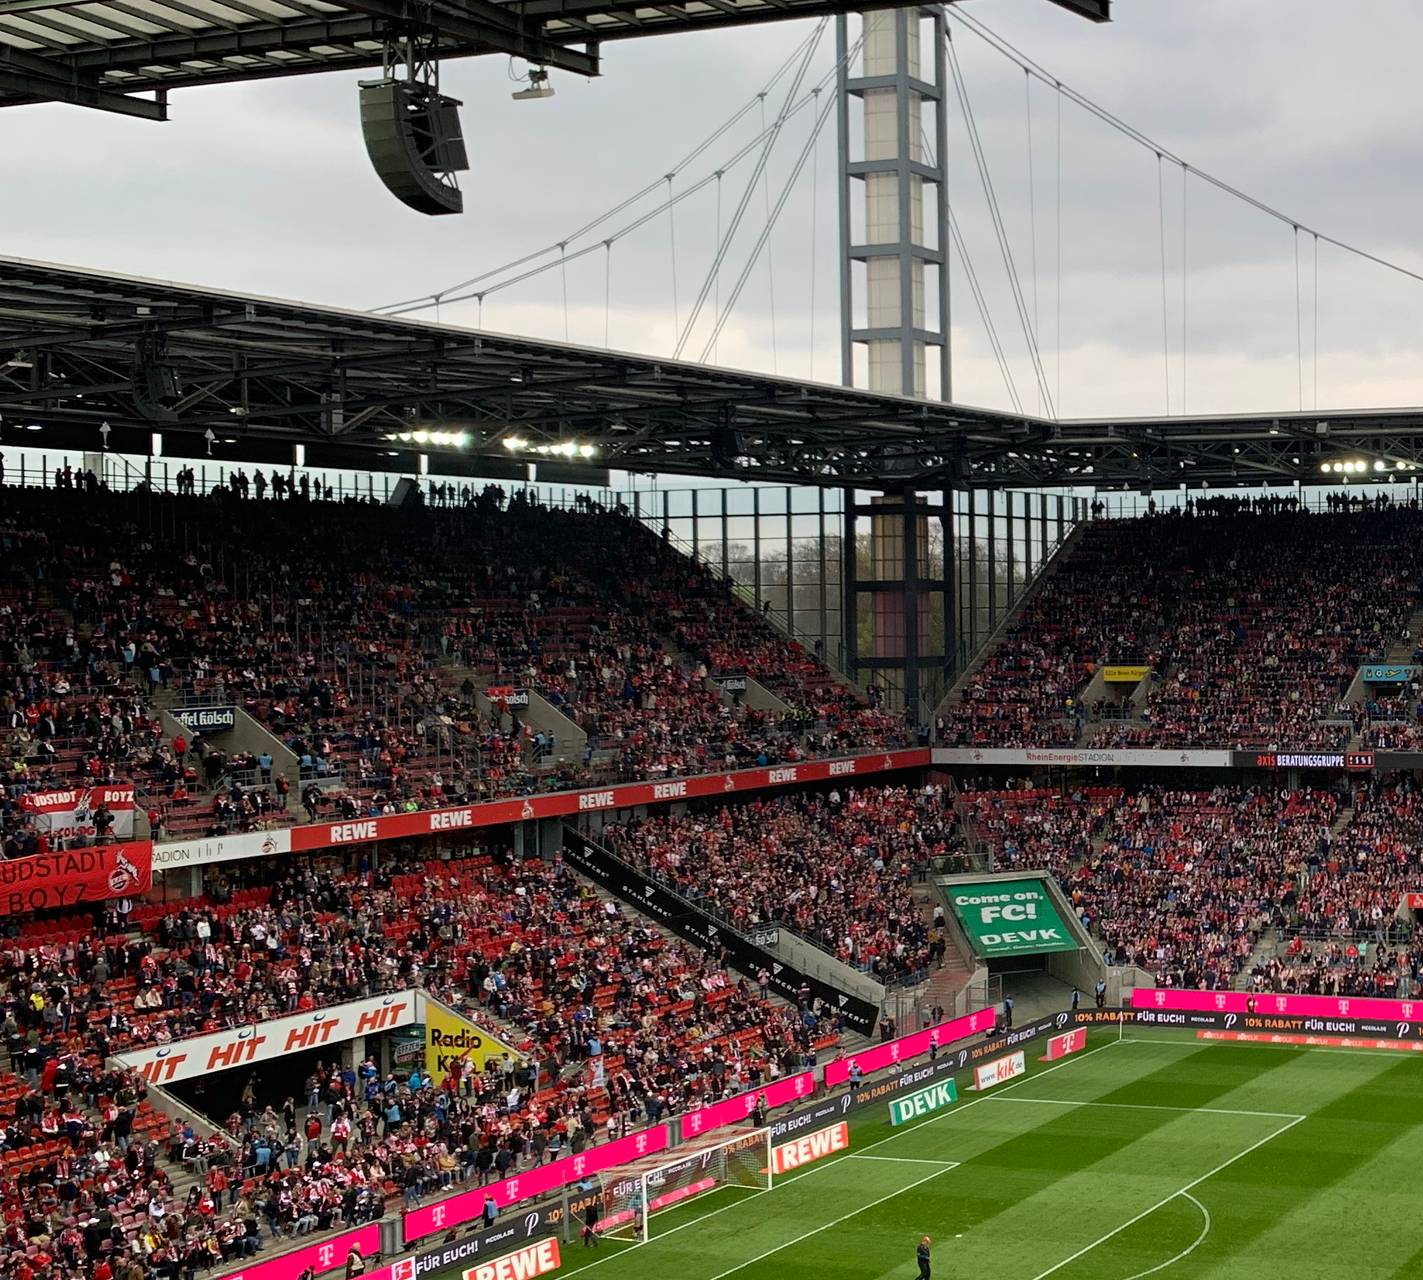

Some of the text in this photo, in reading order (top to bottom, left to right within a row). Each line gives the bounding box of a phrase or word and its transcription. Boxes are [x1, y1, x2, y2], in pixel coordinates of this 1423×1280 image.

[829, 761, 855, 775] REWE
[1257, 755, 1275, 766] axis
[1277, 755, 1344, 768] BERATUNGSGRUPPE
[769, 767, 797, 783] REWE
[105, 791, 134, 802] BOYZ
[654, 781, 687, 798] REWE
[579, 791, 615, 810] REWE
[430, 809, 473, 830] REWE
[330, 821, 378, 843] REWE
[152, 849, 190, 864] ADION
[9, 884, 88, 914] BOYZ
[955, 893, 1011, 906] Come
[981, 903, 1038, 924] FC!
[980, 928, 1062, 946] DEVK
[356, 1003, 408, 1033] HIT
[1075, 1013, 1093, 1022] 10%
[1096, 1012, 1134, 1022] RABATT
[1137, 1011, 1155, 1022] FÜR
[1158, 1012, 1185, 1024] EUCH!
[1245, 1018, 1262, 1028] 10%
[1265, 1018, 1303, 1030] RABATT
[1305, 1020, 1324, 1032] FÜR
[1326, 1022, 1355, 1033] EUCH!
[284, 1019, 339, 1051] HIT
[431, 1029, 481, 1049] Radio
[206, 1036, 266, 1070] HIT
[983, 1039, 1006, 1055] RABATT
[856, 1066, 934, 1104] 10% RABATT FÜR EUCH!
[900, 1083, 952, 1121] DEVK
[771, 1113, 812, 1137] FÜR EUCH!
[782, 1125, 845, 1170] REWE
[415, 1254, 442, 1275] FÜR
[443, 1240, 478, 1266] EUCH!
